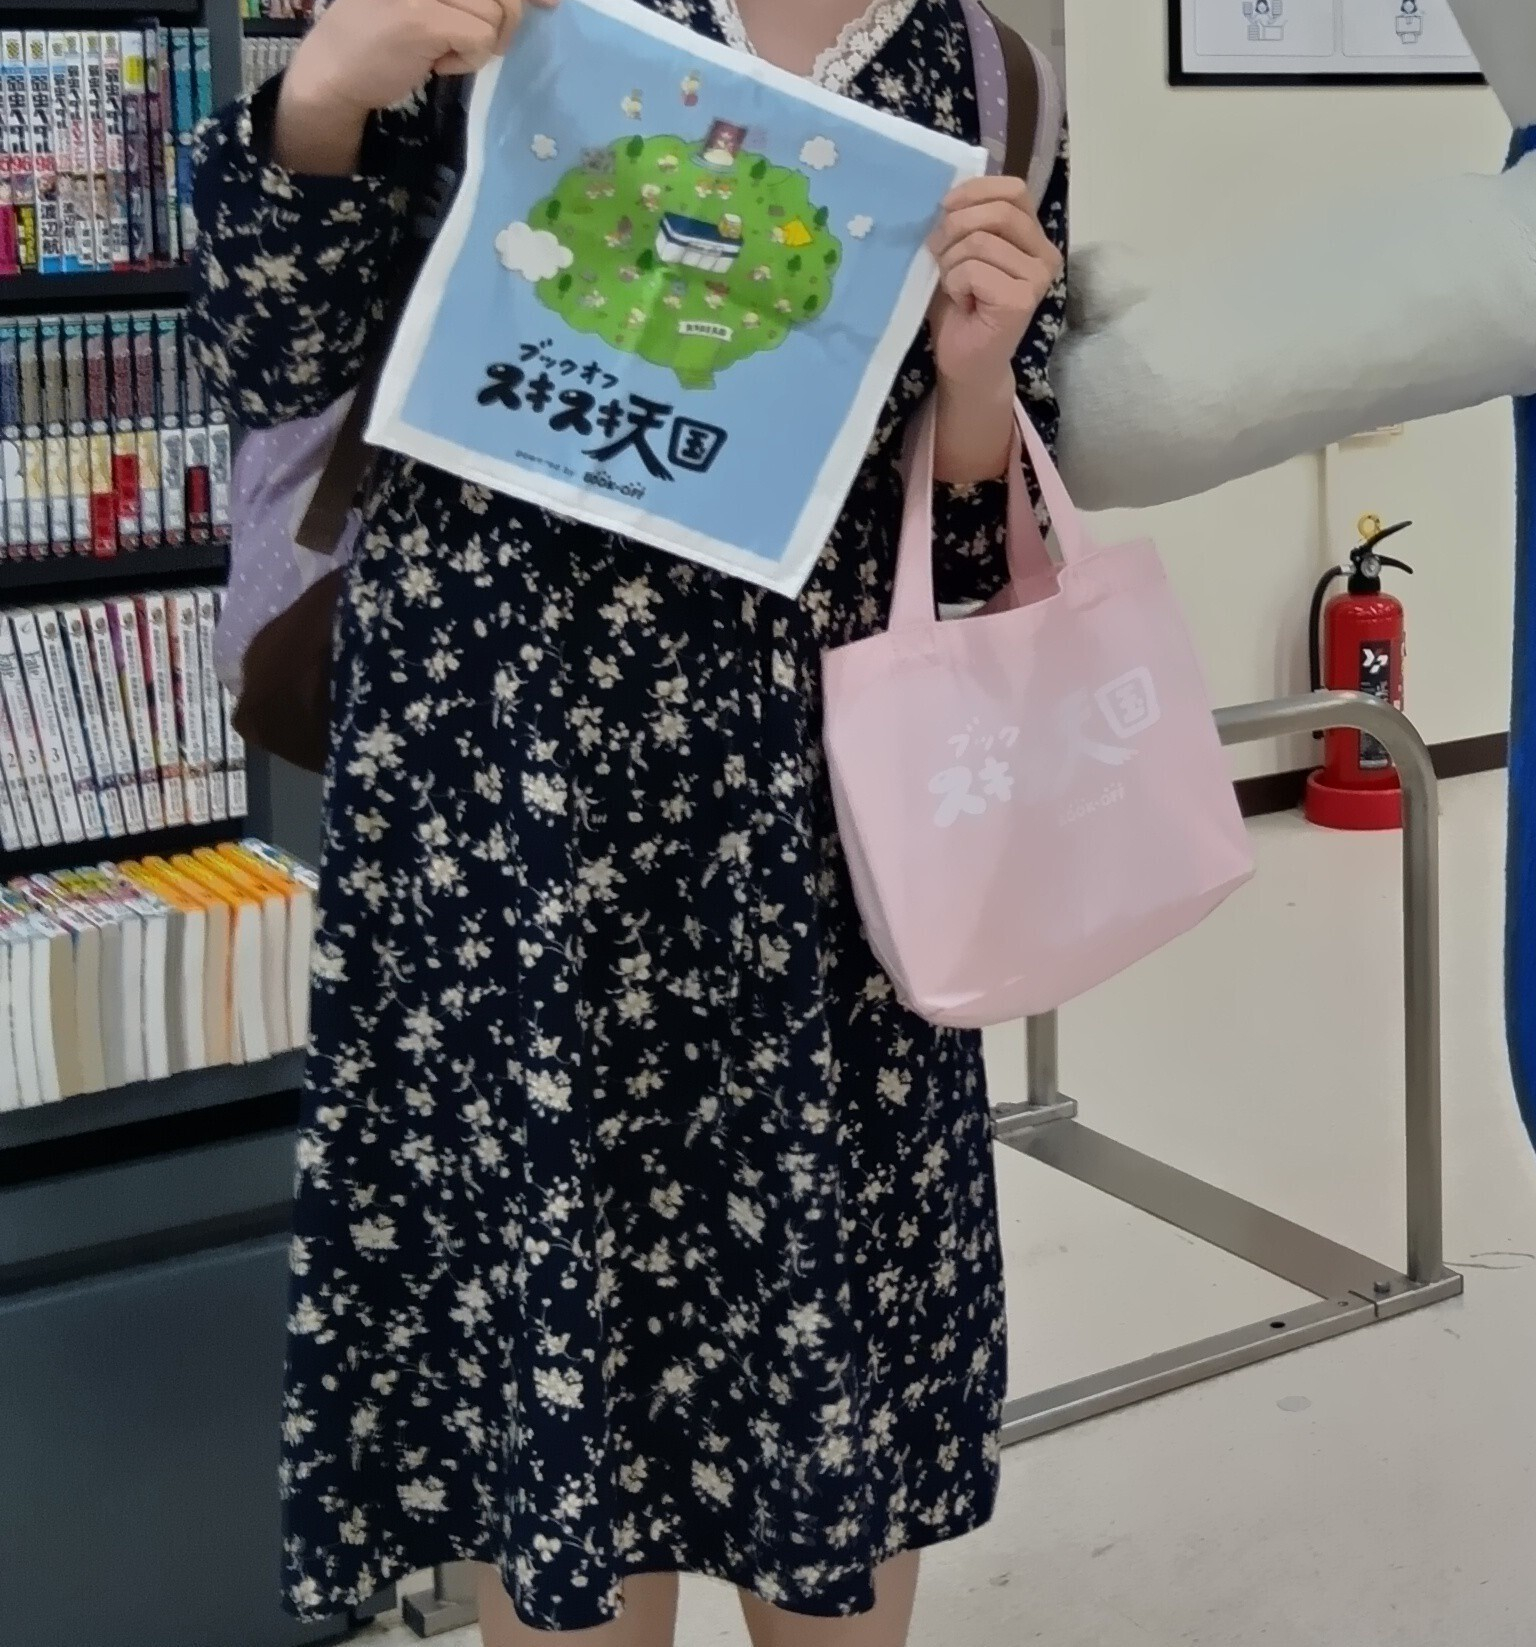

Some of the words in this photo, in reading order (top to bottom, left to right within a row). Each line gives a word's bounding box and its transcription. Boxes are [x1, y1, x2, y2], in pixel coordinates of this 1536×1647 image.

[519, 338, 619, 389] ブックオフ
[477, 362, 728, 482] スキスキ天国
